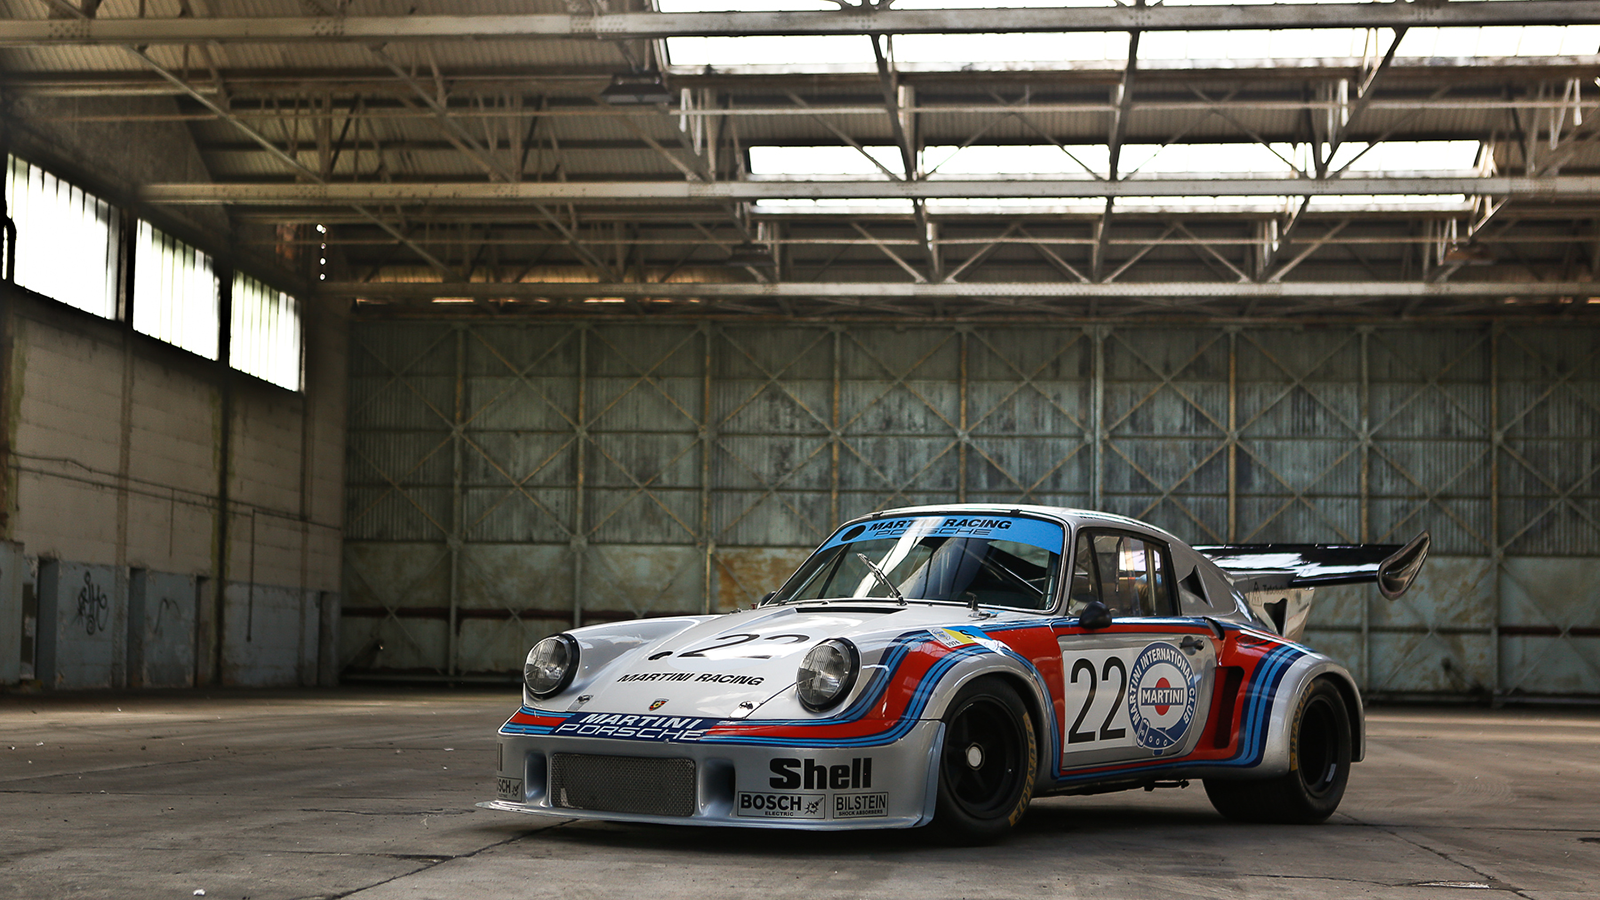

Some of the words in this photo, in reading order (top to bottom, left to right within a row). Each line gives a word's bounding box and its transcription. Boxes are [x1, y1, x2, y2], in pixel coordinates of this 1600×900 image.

[869, 519, 940, 531] MARTINI
[942, 519, 1012, 529] RACING
[874, 527, 992, 537] PORSCHE
[616, 672, 695, 683] MARTINI
[694, 673, 765, 686] RACING
[1129, 664, 1142, 726] MARTINI
[1140, 648, 1193, 685] INTERNATIONAL
[1183, 687, 1196, 724] CLUB
[1068, 656, 1127, 744] 22
[1142, 689, 1184, 704] MARTINI
[579, 713, 703, 729] MARTINI
[554, 723, 705, 741] PORSCHE
[769, 757, 872, 790] Shell
[740, 794, 802, 811] BOSCH
[836, 795, 886, 811] BILSTEIN
